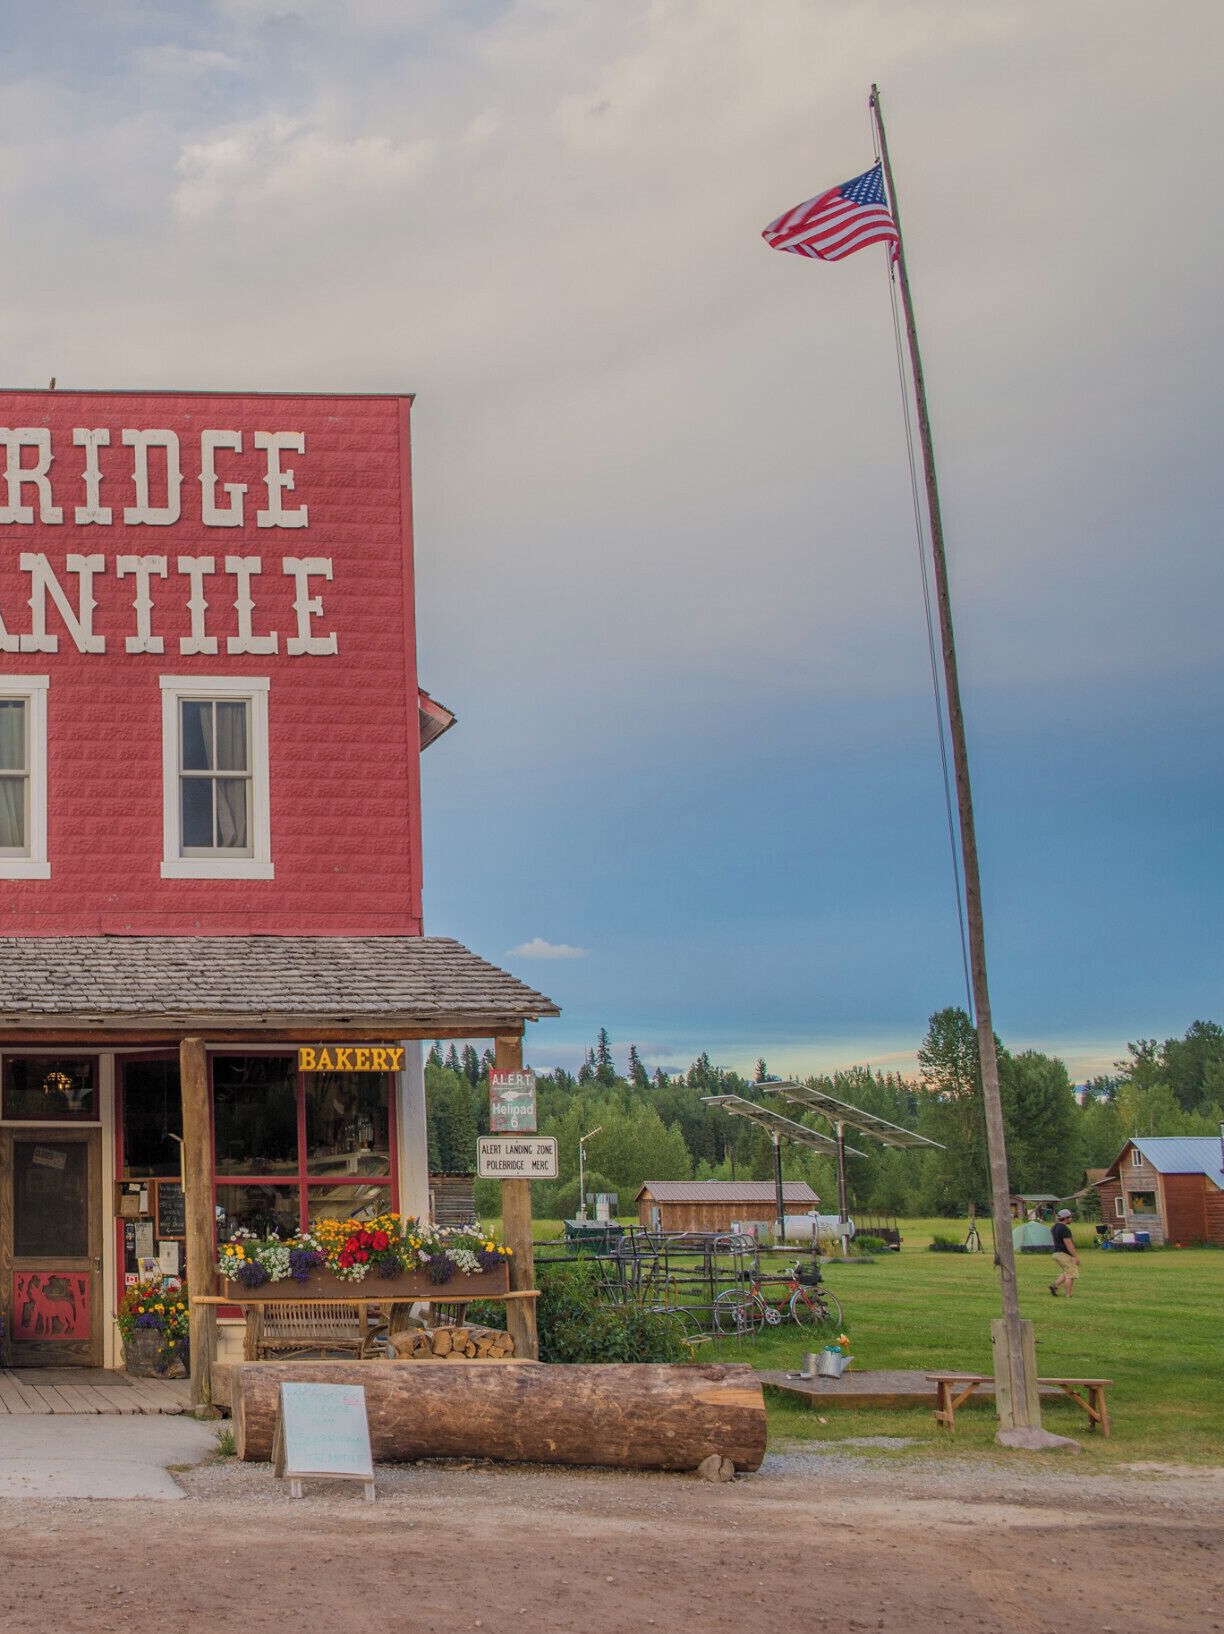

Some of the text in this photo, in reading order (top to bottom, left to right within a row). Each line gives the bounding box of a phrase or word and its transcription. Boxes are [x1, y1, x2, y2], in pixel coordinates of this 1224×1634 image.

[299, 1047, 405, 1072] BAKERY
[492, 1102, 535, 1117] Helipad
[510, 1116, 519, 1128] 6
[481, 1144, 553, 1155] ALERT LANDING ZONE
[486, 1160, 549, 1170] POLEBRIDGE MERC
